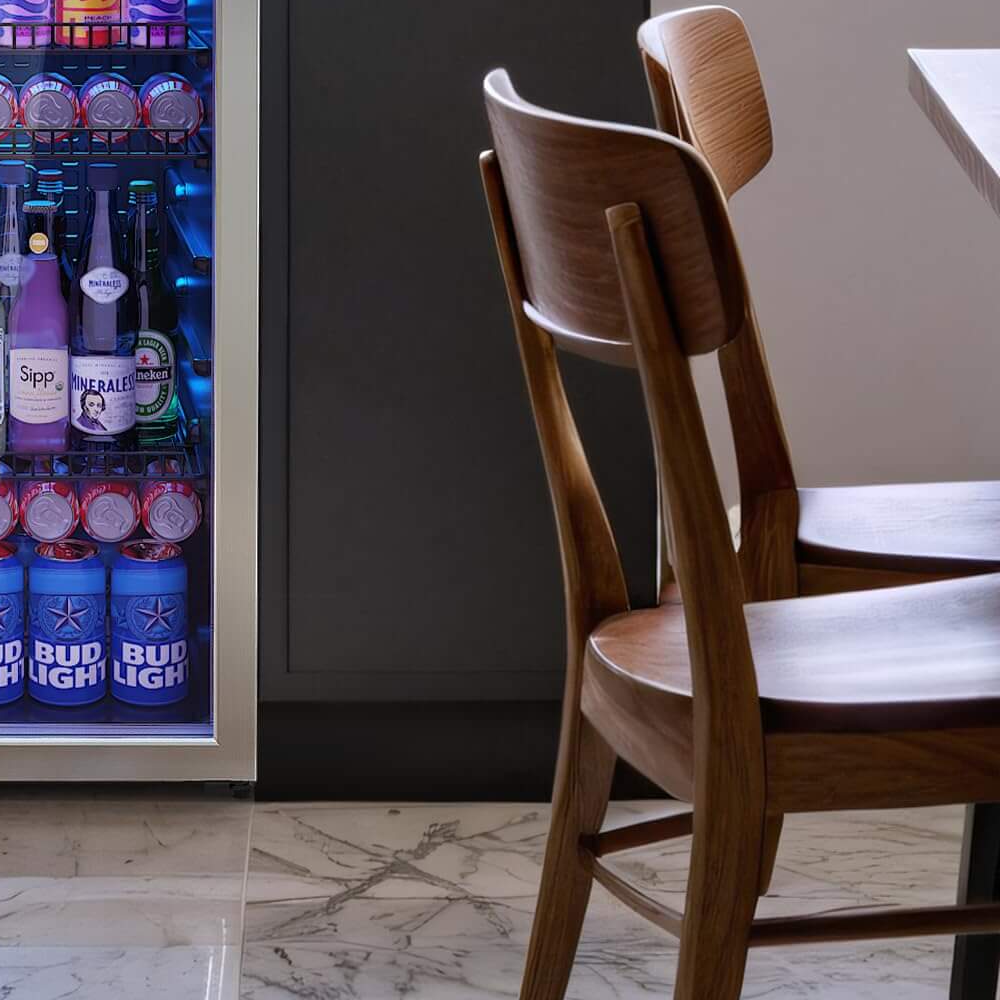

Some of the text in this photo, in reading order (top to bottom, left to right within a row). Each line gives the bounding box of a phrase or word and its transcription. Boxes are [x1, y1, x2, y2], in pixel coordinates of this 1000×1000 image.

[19, 364, 55, 389] Sipp
[34, 639, 102, 667] BUD
[122, 639, 188, 667] BUD
[28, 656, 108, 690] LIGHT
